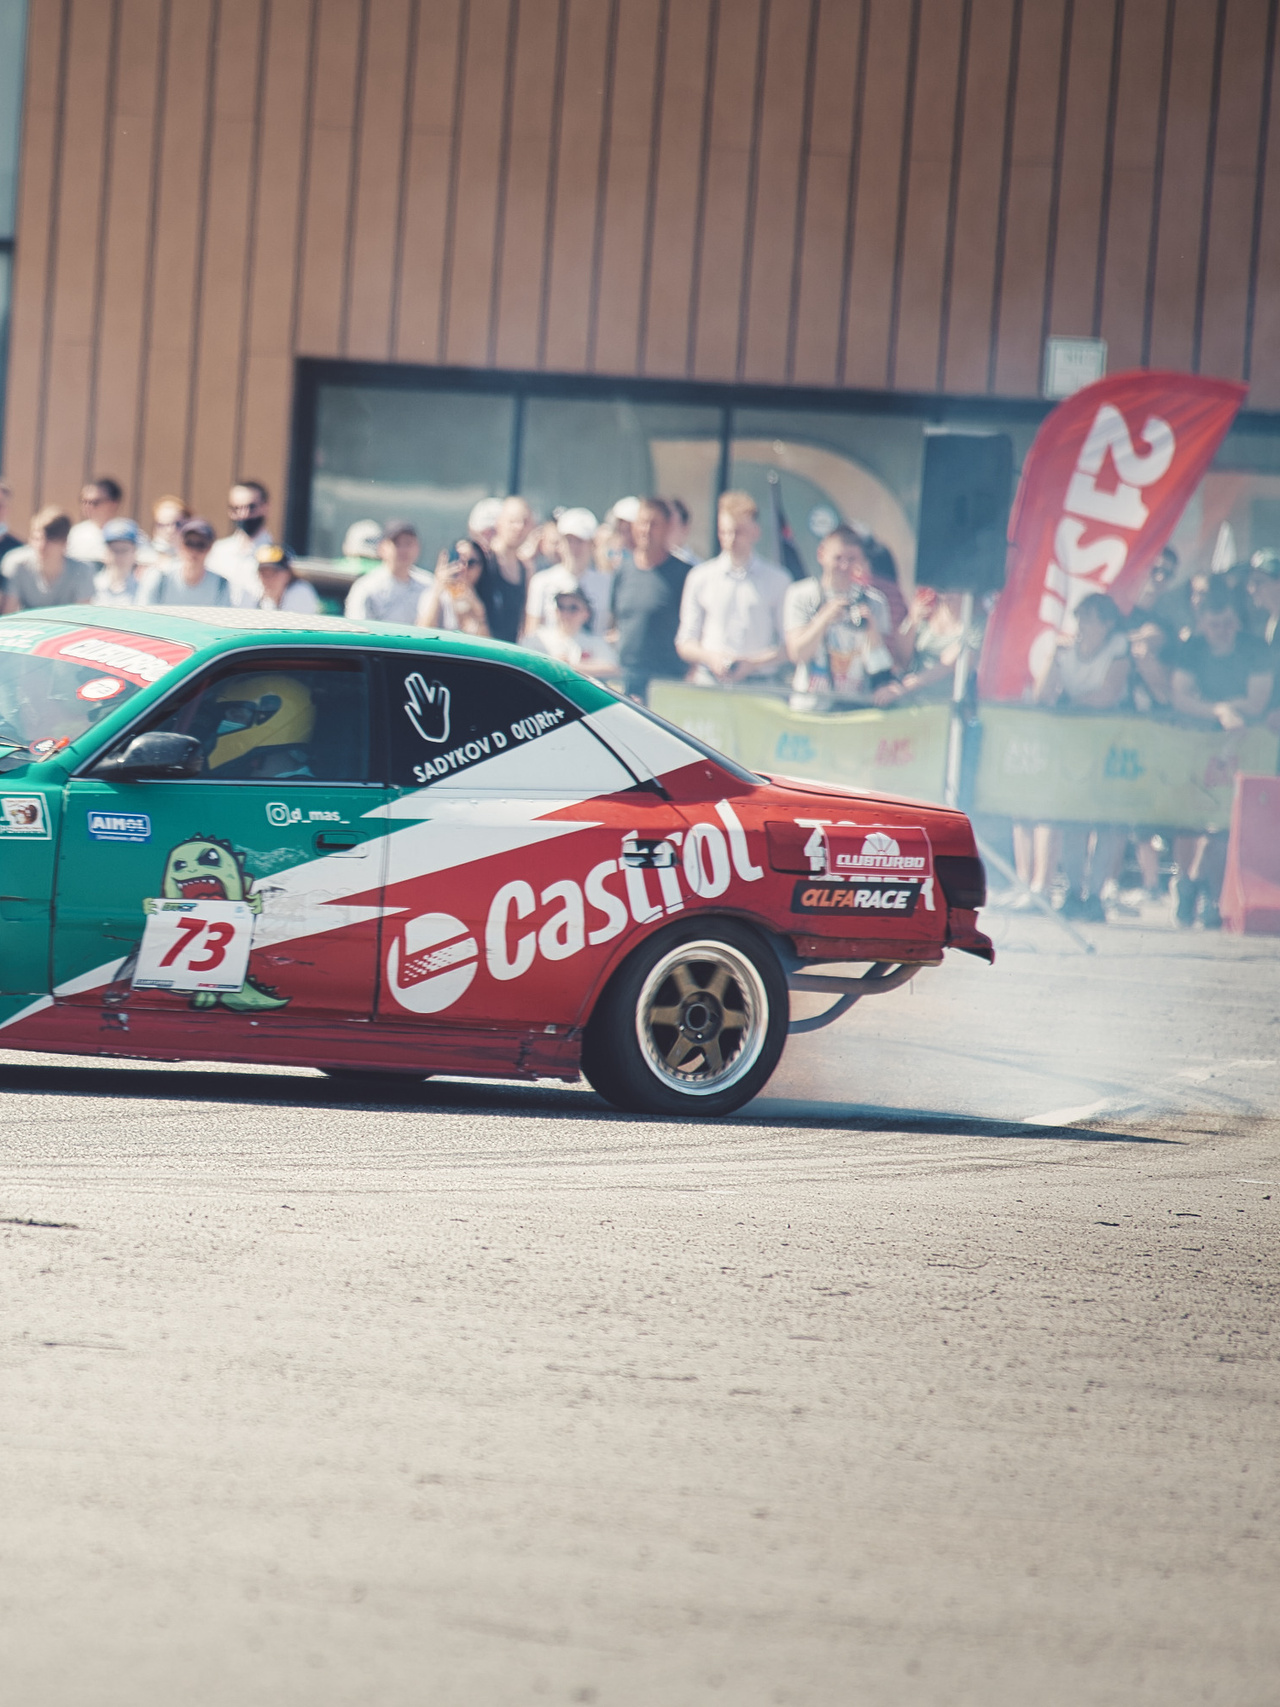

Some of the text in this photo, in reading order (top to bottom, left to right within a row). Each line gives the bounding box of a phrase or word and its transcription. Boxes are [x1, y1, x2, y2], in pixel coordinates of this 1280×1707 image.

[413, 736, 491, 783] SADYKOV
[492, 731, 508, 749] D
[836, 854, 925, 869] CLUBTURBO
[485, 799, 764, 980] Castrol
[158, 917, 236, 972] 73
